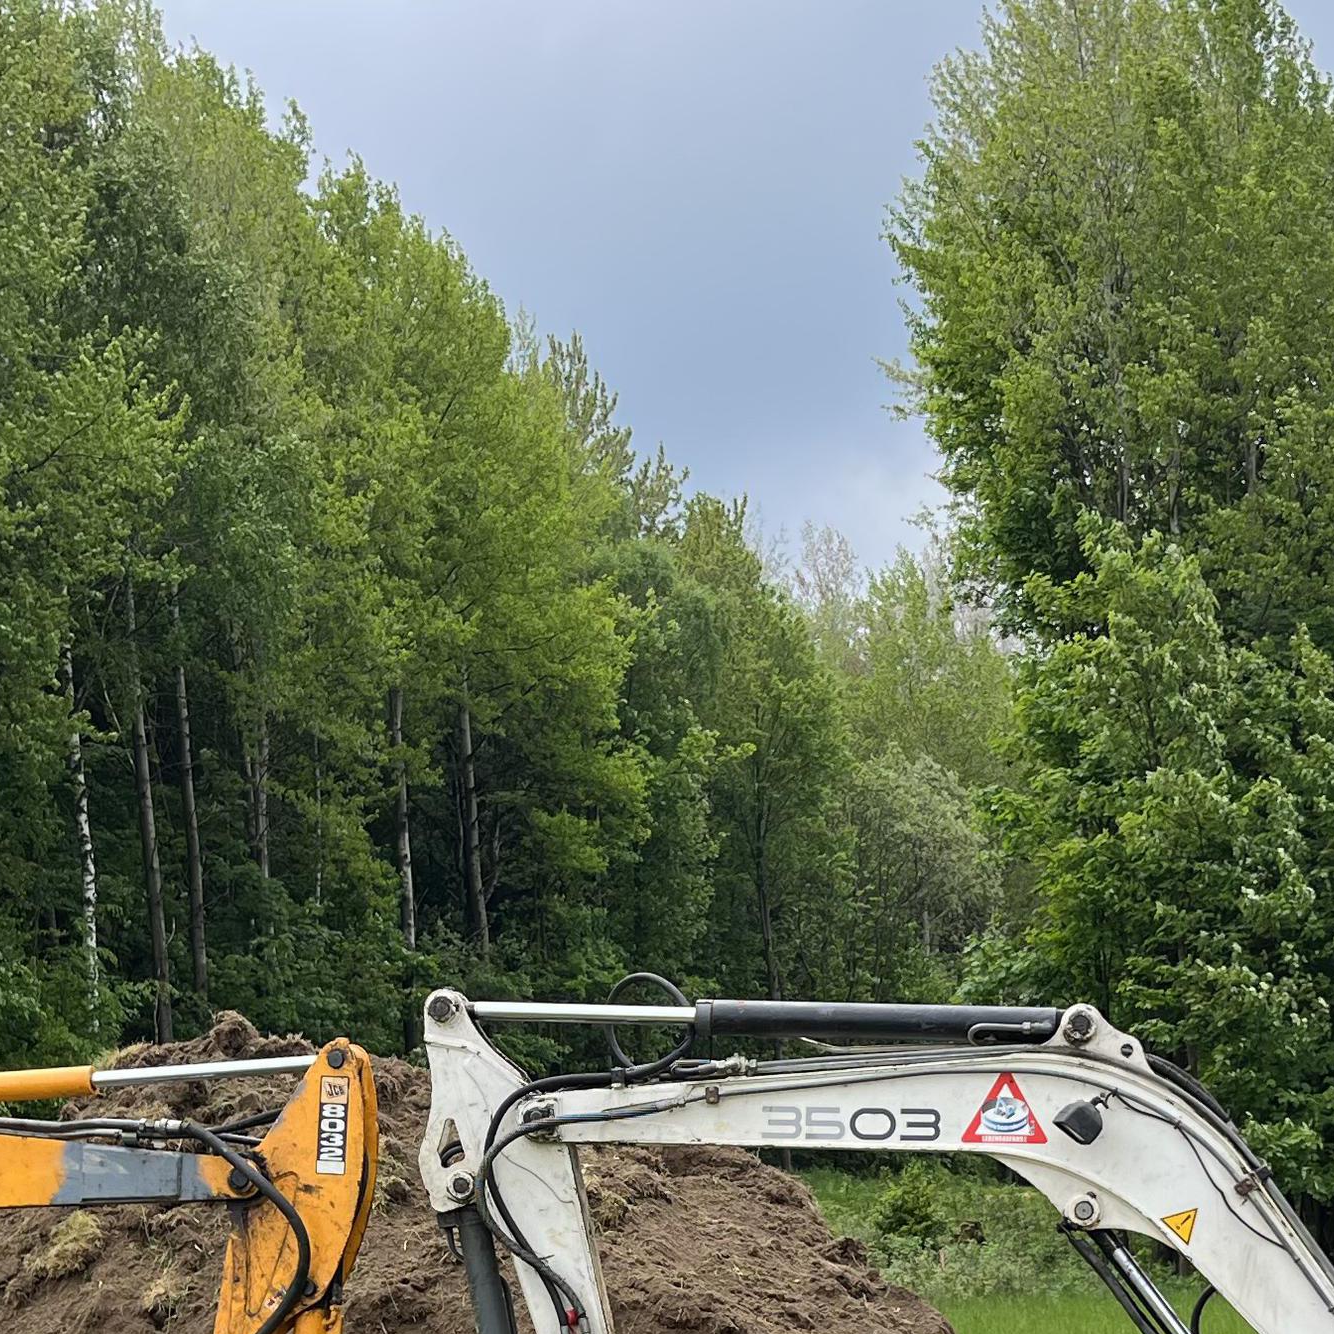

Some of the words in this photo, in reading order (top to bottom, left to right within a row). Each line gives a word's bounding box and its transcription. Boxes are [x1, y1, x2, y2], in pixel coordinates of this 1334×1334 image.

[326, 1083, 345, 1097] JCB
[319, 1104, 346, 1162] 8032
[761, 1105, 941, 1141] 3503
